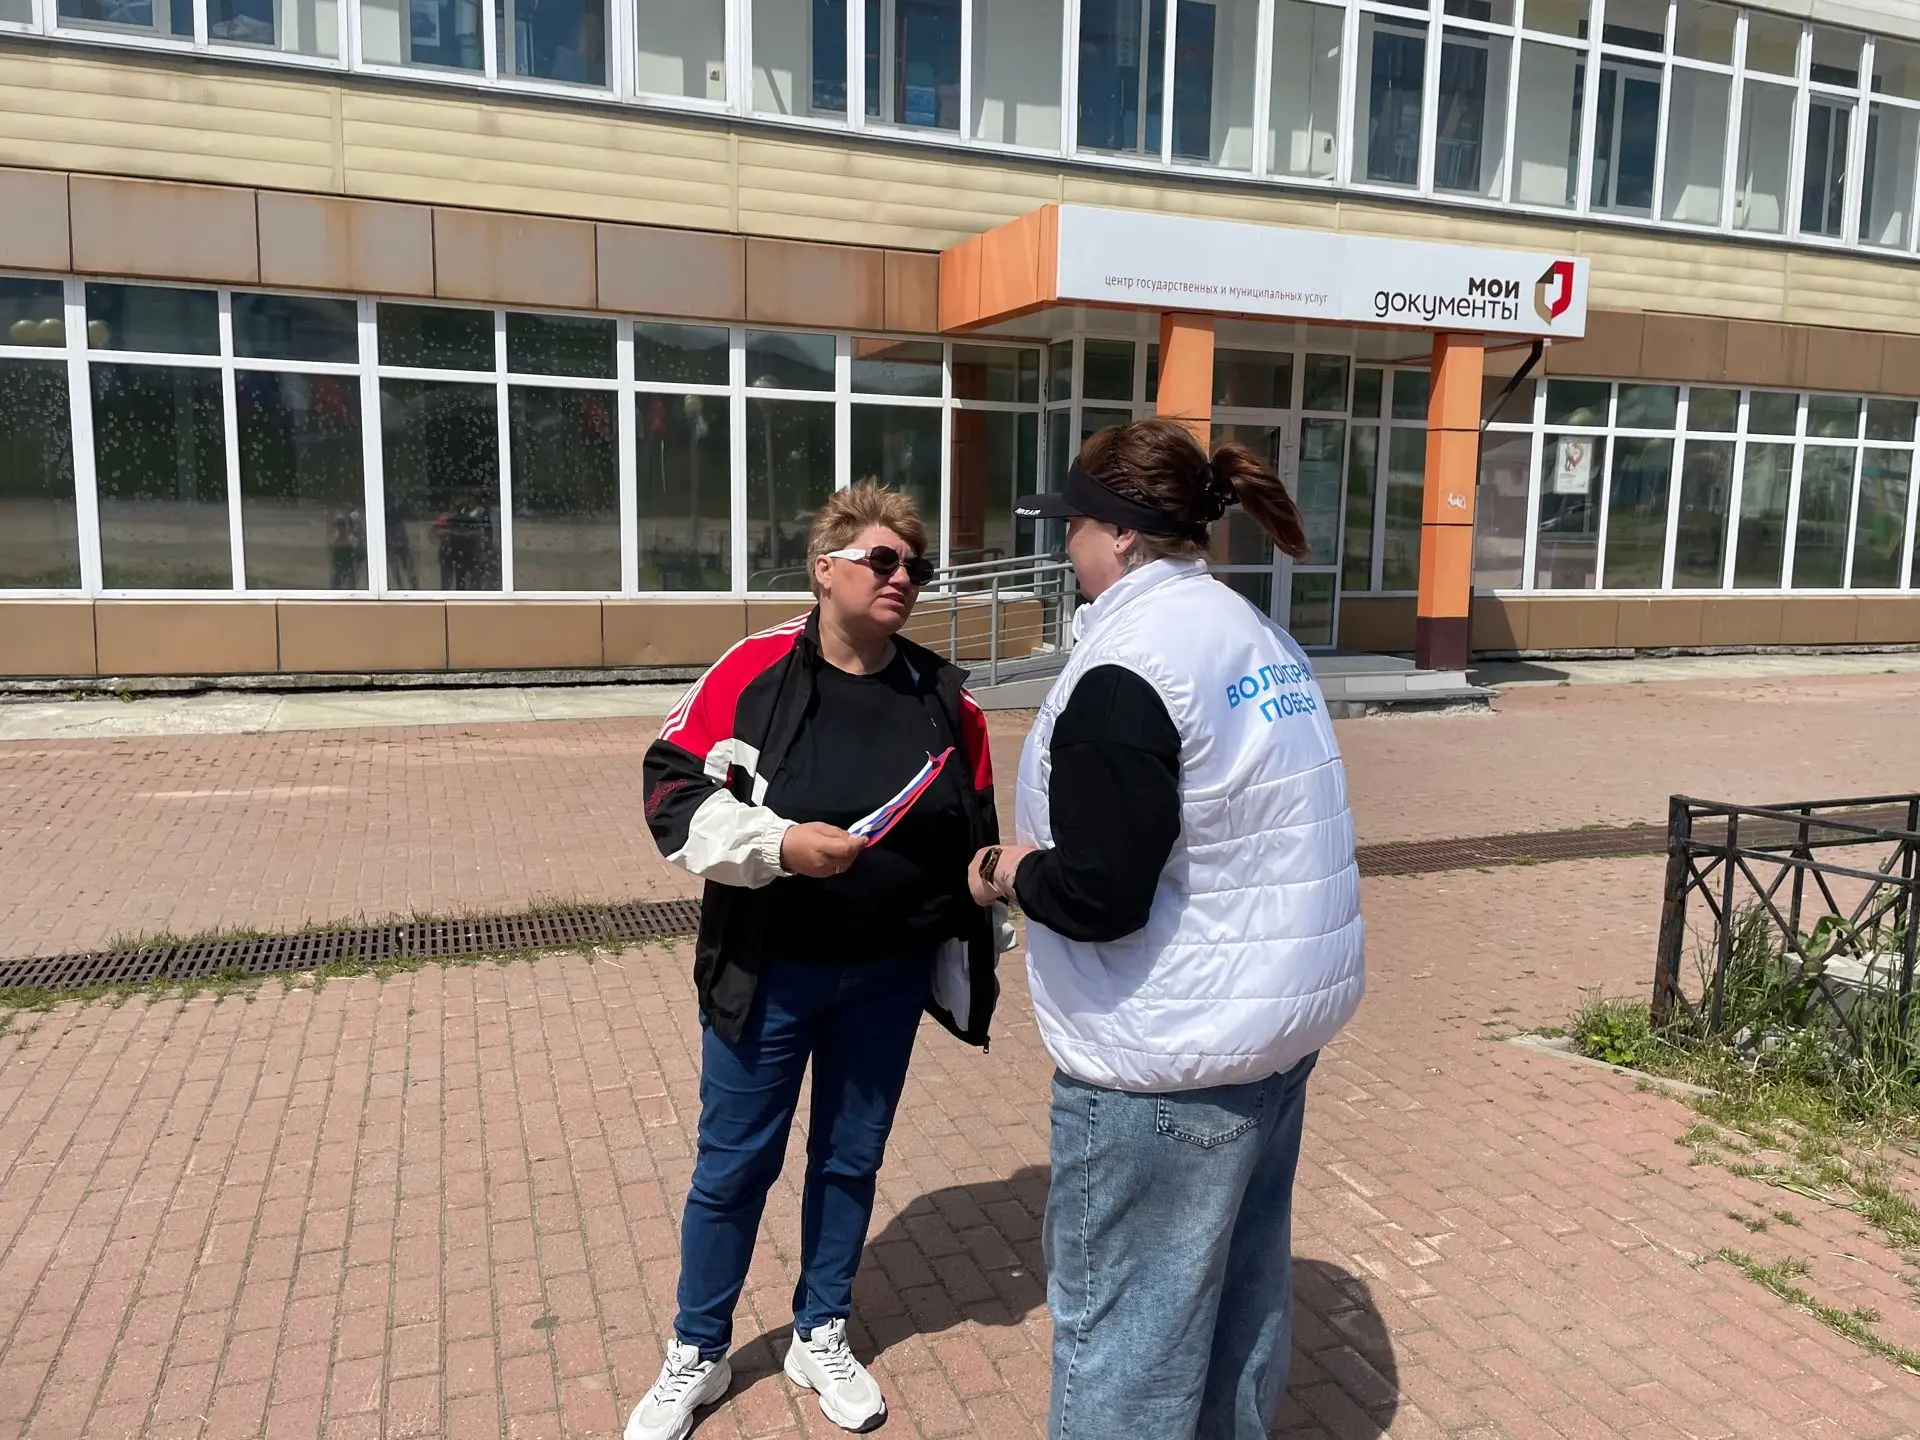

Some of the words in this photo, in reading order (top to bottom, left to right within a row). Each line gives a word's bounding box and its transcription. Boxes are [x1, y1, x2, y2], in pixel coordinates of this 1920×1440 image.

[1104, 275, 1134, 290] центр
[1136, 278, 1218, 294] государственных
[1220, 285, 1227, 295] и
[1229, 286, 1302, 301] муниципальных
[1304, 292, 1328, 306] услуг
[1374, 290, 1519, 322] документы
